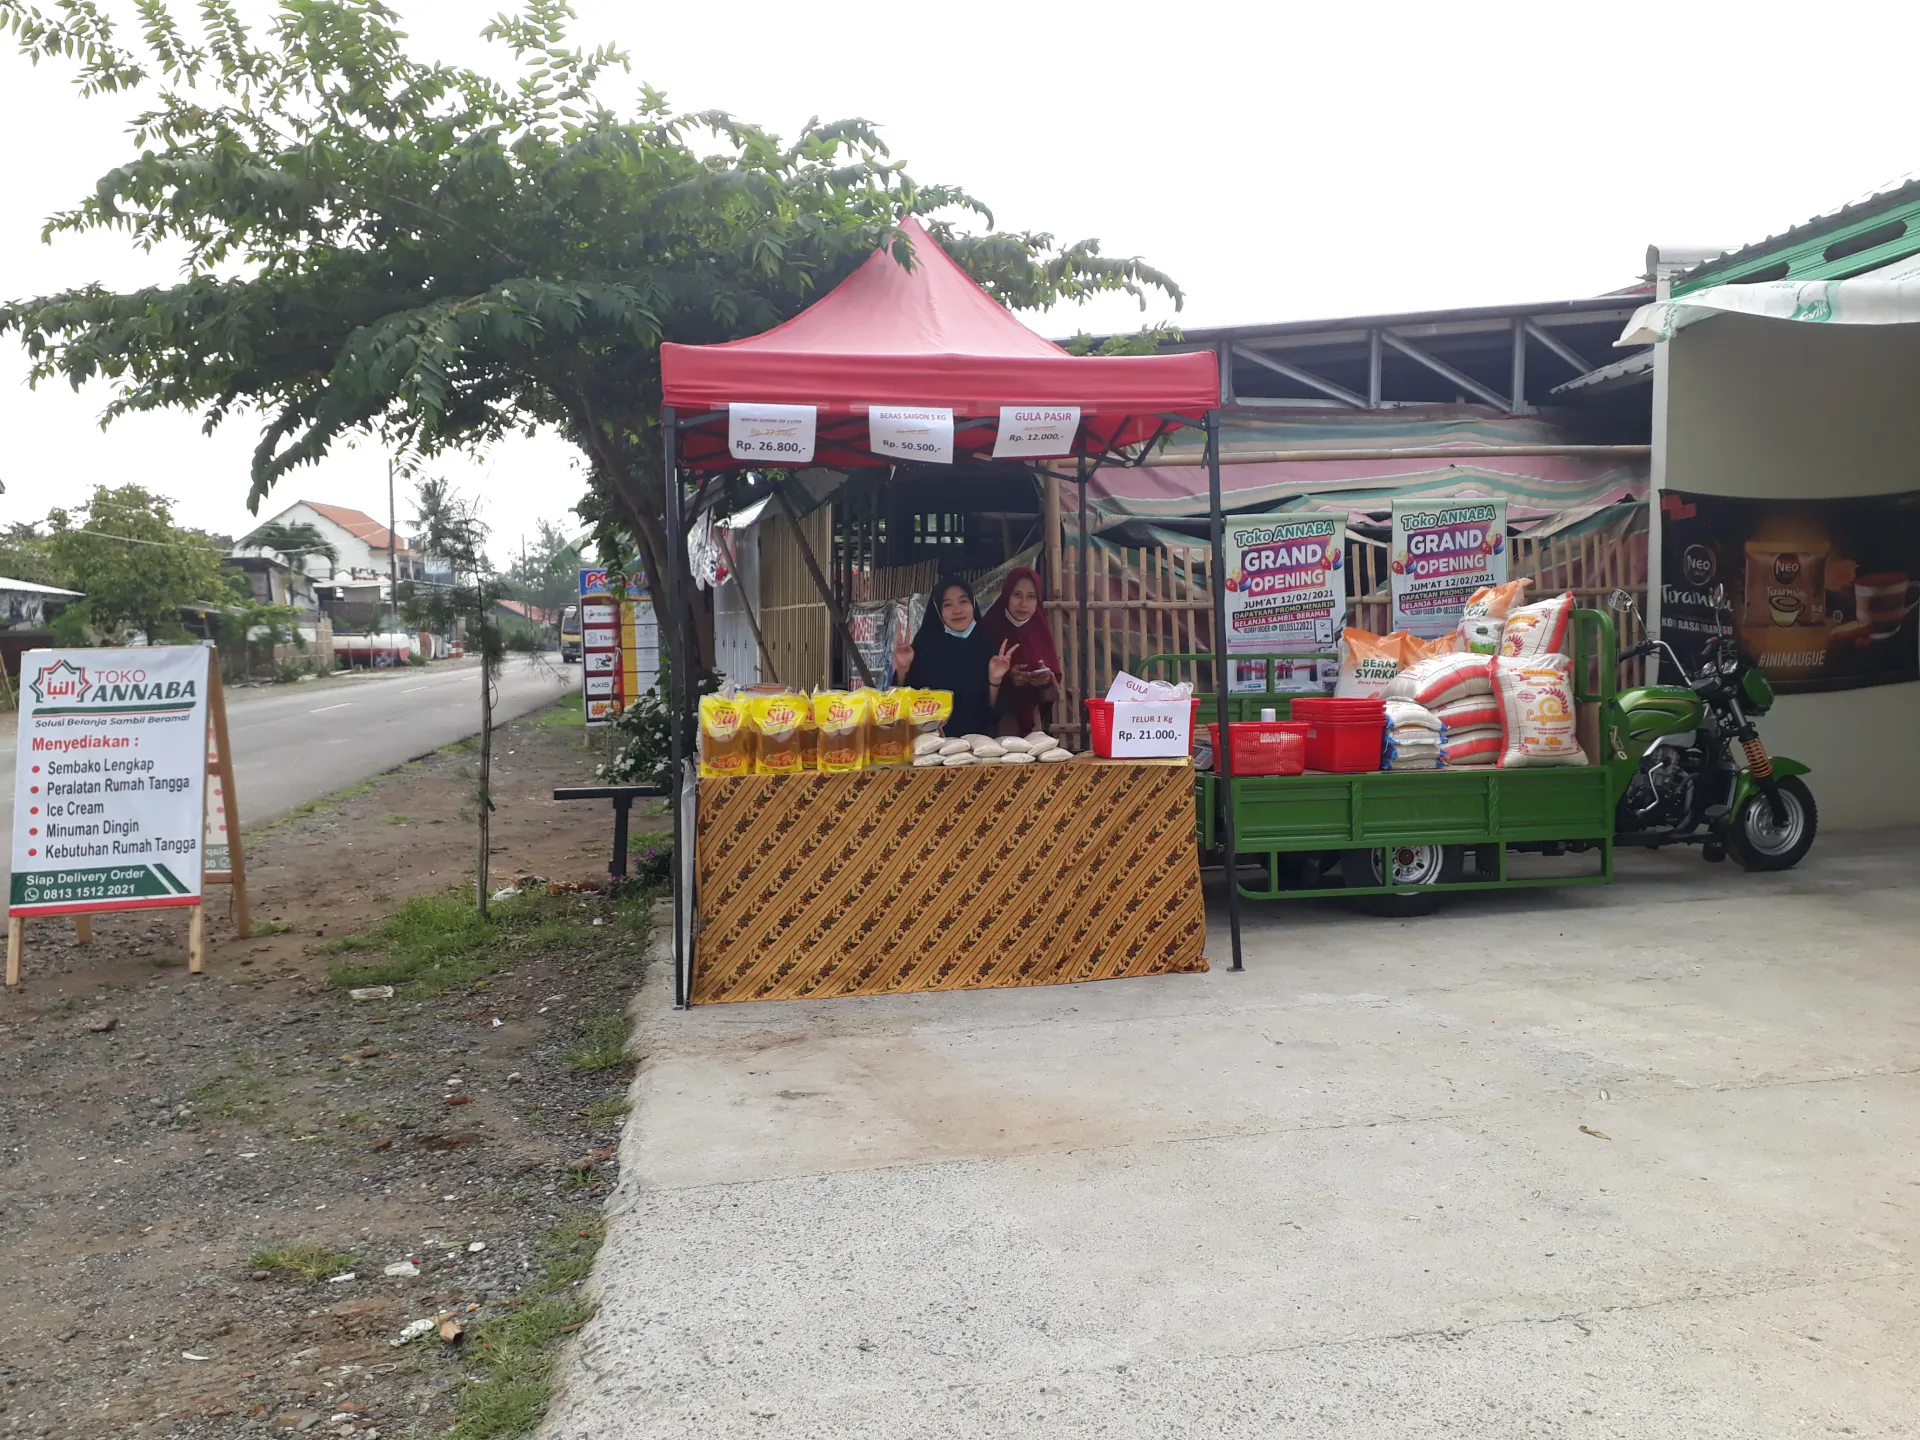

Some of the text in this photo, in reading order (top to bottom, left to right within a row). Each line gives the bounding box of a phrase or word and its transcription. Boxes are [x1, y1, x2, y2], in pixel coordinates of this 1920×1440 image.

[1015, 411, 1072, 422] GULA PASIR
[882, 440, 941, 453] Rp. 50.500,-
[1009, 432, 1064, 443] Rp. 12.000,-
[736, 440, 806, 454] Rp. 26.800,-
[1403, 506, 1494, 529] Toko ANNABA
[1236, 522, 1333, 546] Toko ANNABA
[1410, 529, 1483, 554] GRAND
[1244, 544, 1322, 572] GRAND
[1416, 554, 1485, 575] OPENING
[1251, 570, 1324, 592] OPENING
[1410, 574, 1495, 592] JUM'AT 12/02/2021
[1243, 590, 1334, 610] JUM'AT 12/02/2021
[1401, 591, 1438, 602] DAPATKAN
[1440, 588, 1464, 596] PROMO
[1401, 601, 1431, 610] BELANJA
[1432, 598, 1460, 607] SAMBIL
[1234, 600, 1335, 620] DAPATKAN PROMO MENARIK
[1234, 609, 1329, 628] BELANJA SAMBIL BERAMAL
[1678, 620, 1700, 632] RASA
[1362, 659, 1398, 669] BERAS
[1758, 651, 1827, 667] #INIMAUGUE
[95, 669, 146, 684] TOKO
[91, 680, 196, 702] ANNABA
[1126, 680, 1148, 694] GULA
[35, 714, 190, 728] Solusi Belanja Sambil Beramal
[1132, 715, 1156, 724] TELUR
[1162, 715, 1173, 725] Kg
[32, 736, 130, 754] Menyediakan
[1118, 730, 1182, 742] Rp. 21.000,-
[48, 758, 154, 776] Sembako Lengkap
[47, 776, 190, 796] Peralatan Rumah Tangga
[47, 801, 104, 817] Ice Cream
[46, 819, 139, 838] Minuman Dingin
[45, 838, 196, 859] Kebutuhan Rumah Tangga
[26, 868, 146, 887] Siap Delivery Order
[44, 884, 135, 900] 0813 1512 2021
